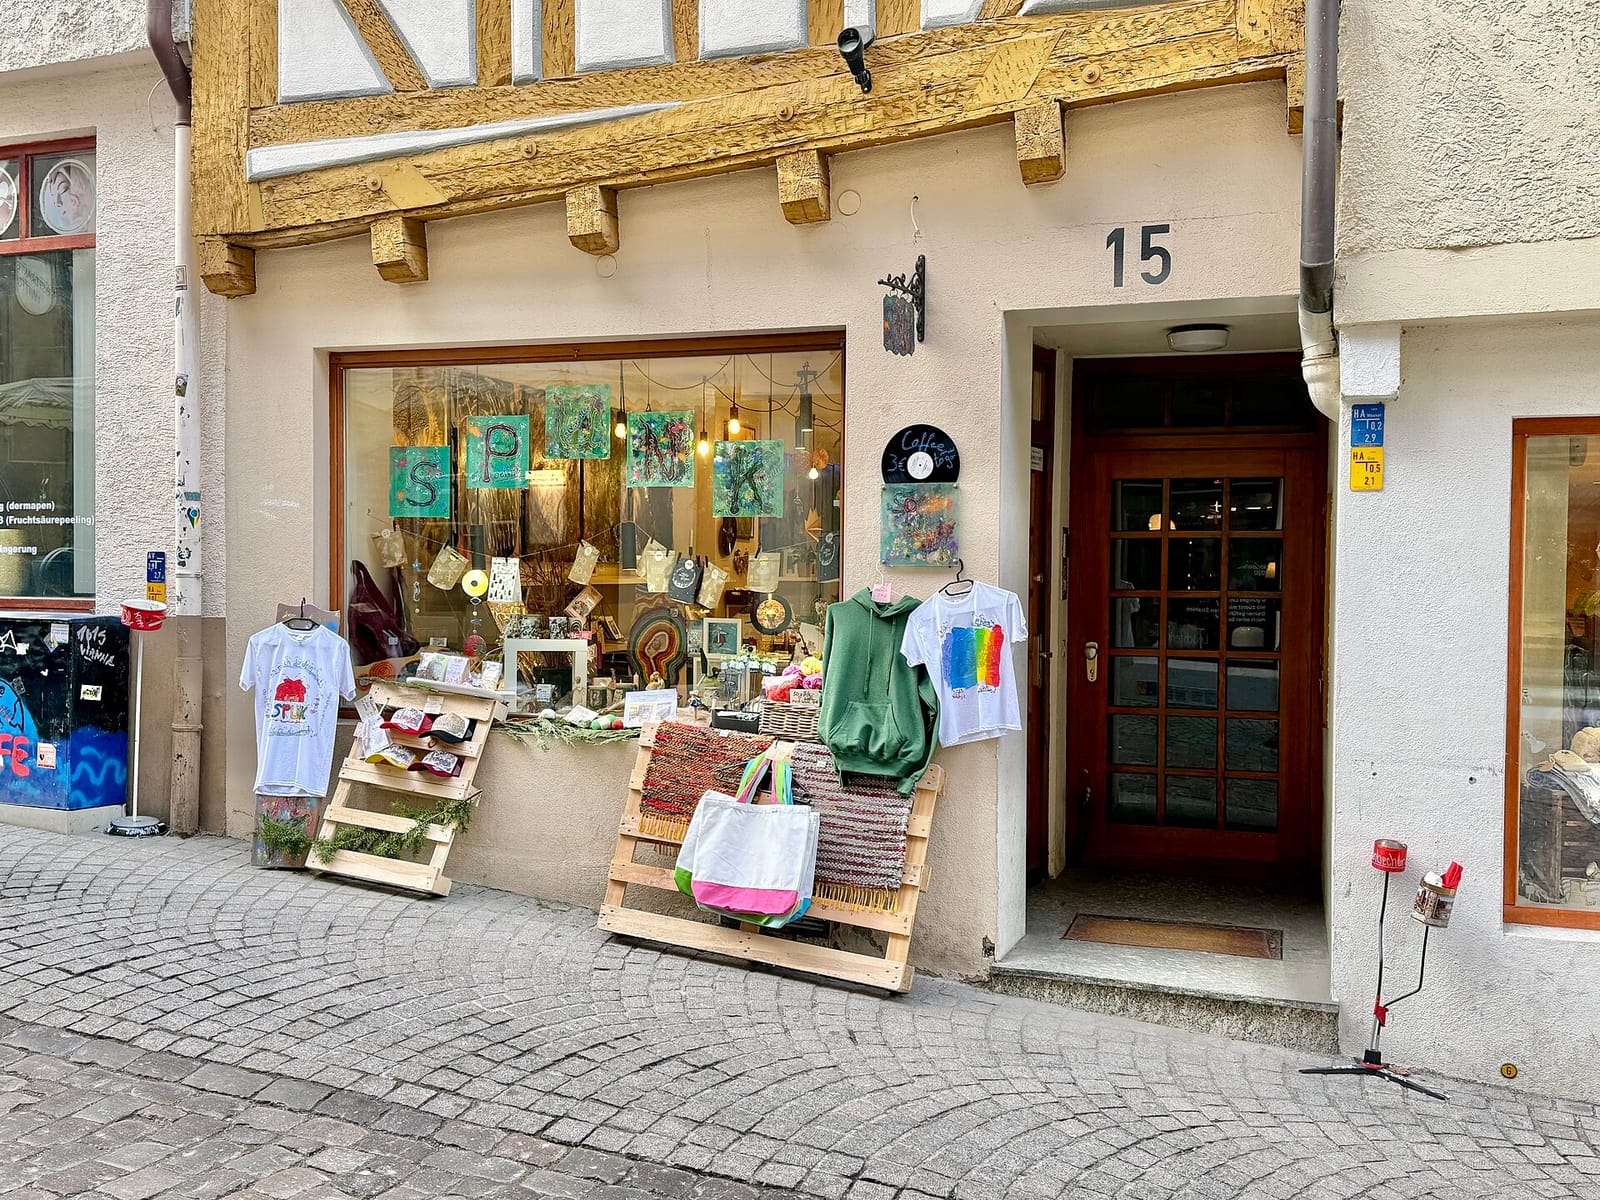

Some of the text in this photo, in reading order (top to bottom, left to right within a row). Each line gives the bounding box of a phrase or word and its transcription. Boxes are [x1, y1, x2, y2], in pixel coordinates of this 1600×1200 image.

[1106, 224, 1171, 288] 15
[901, 430, 945, 452] Coffee
[6, 501, 55, 512] (dermapen)
[6, 515, 95, 526] (Fruchtsäurepeeling)
